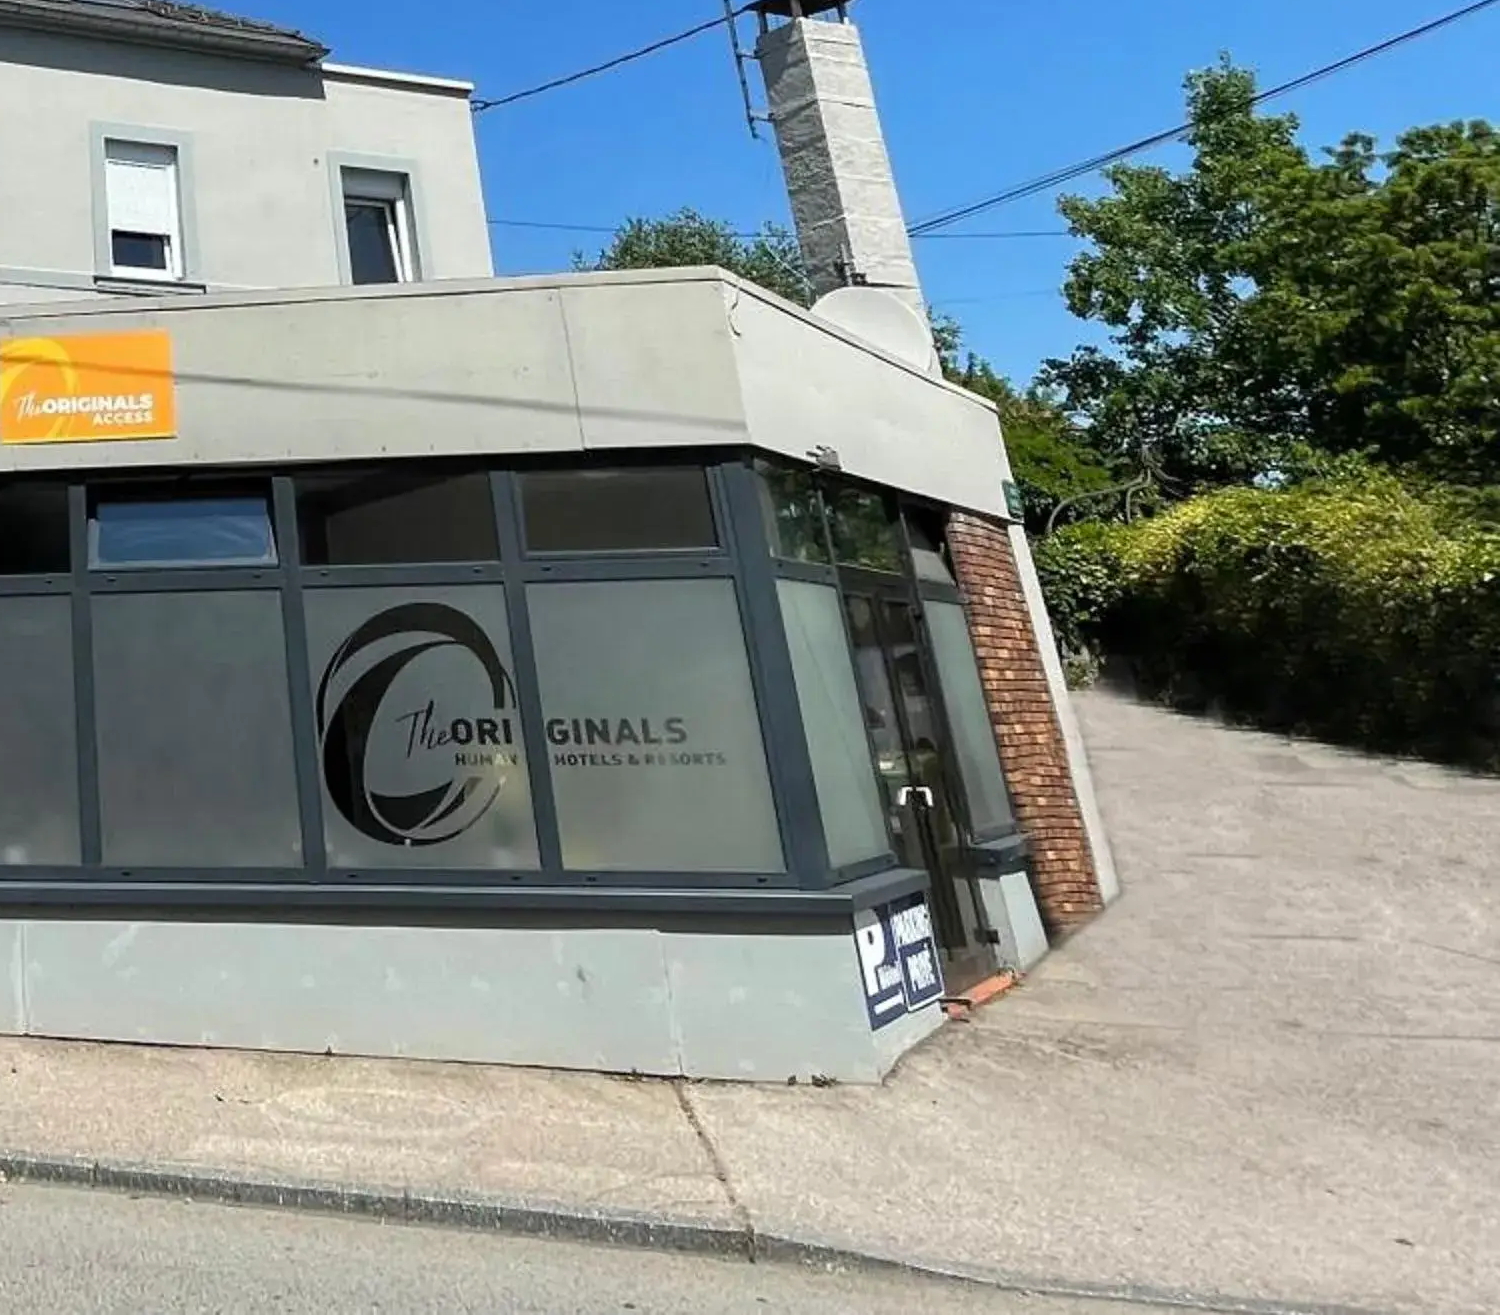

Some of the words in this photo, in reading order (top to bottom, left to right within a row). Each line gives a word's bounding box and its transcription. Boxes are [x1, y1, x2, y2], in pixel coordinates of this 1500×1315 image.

[13, 390, 44, 423] The
[41, 393, 154, 415] ORIGINALS
[92, 412, 153, 426] ACCESS
[396, 699, 452, 760] The
[455, 752, 518, 766] HUMAN
[554, 753, 623, 766] HOTELS
[627, 754, 640, 766] &
[645, 751, 727, 766] RESORTS
